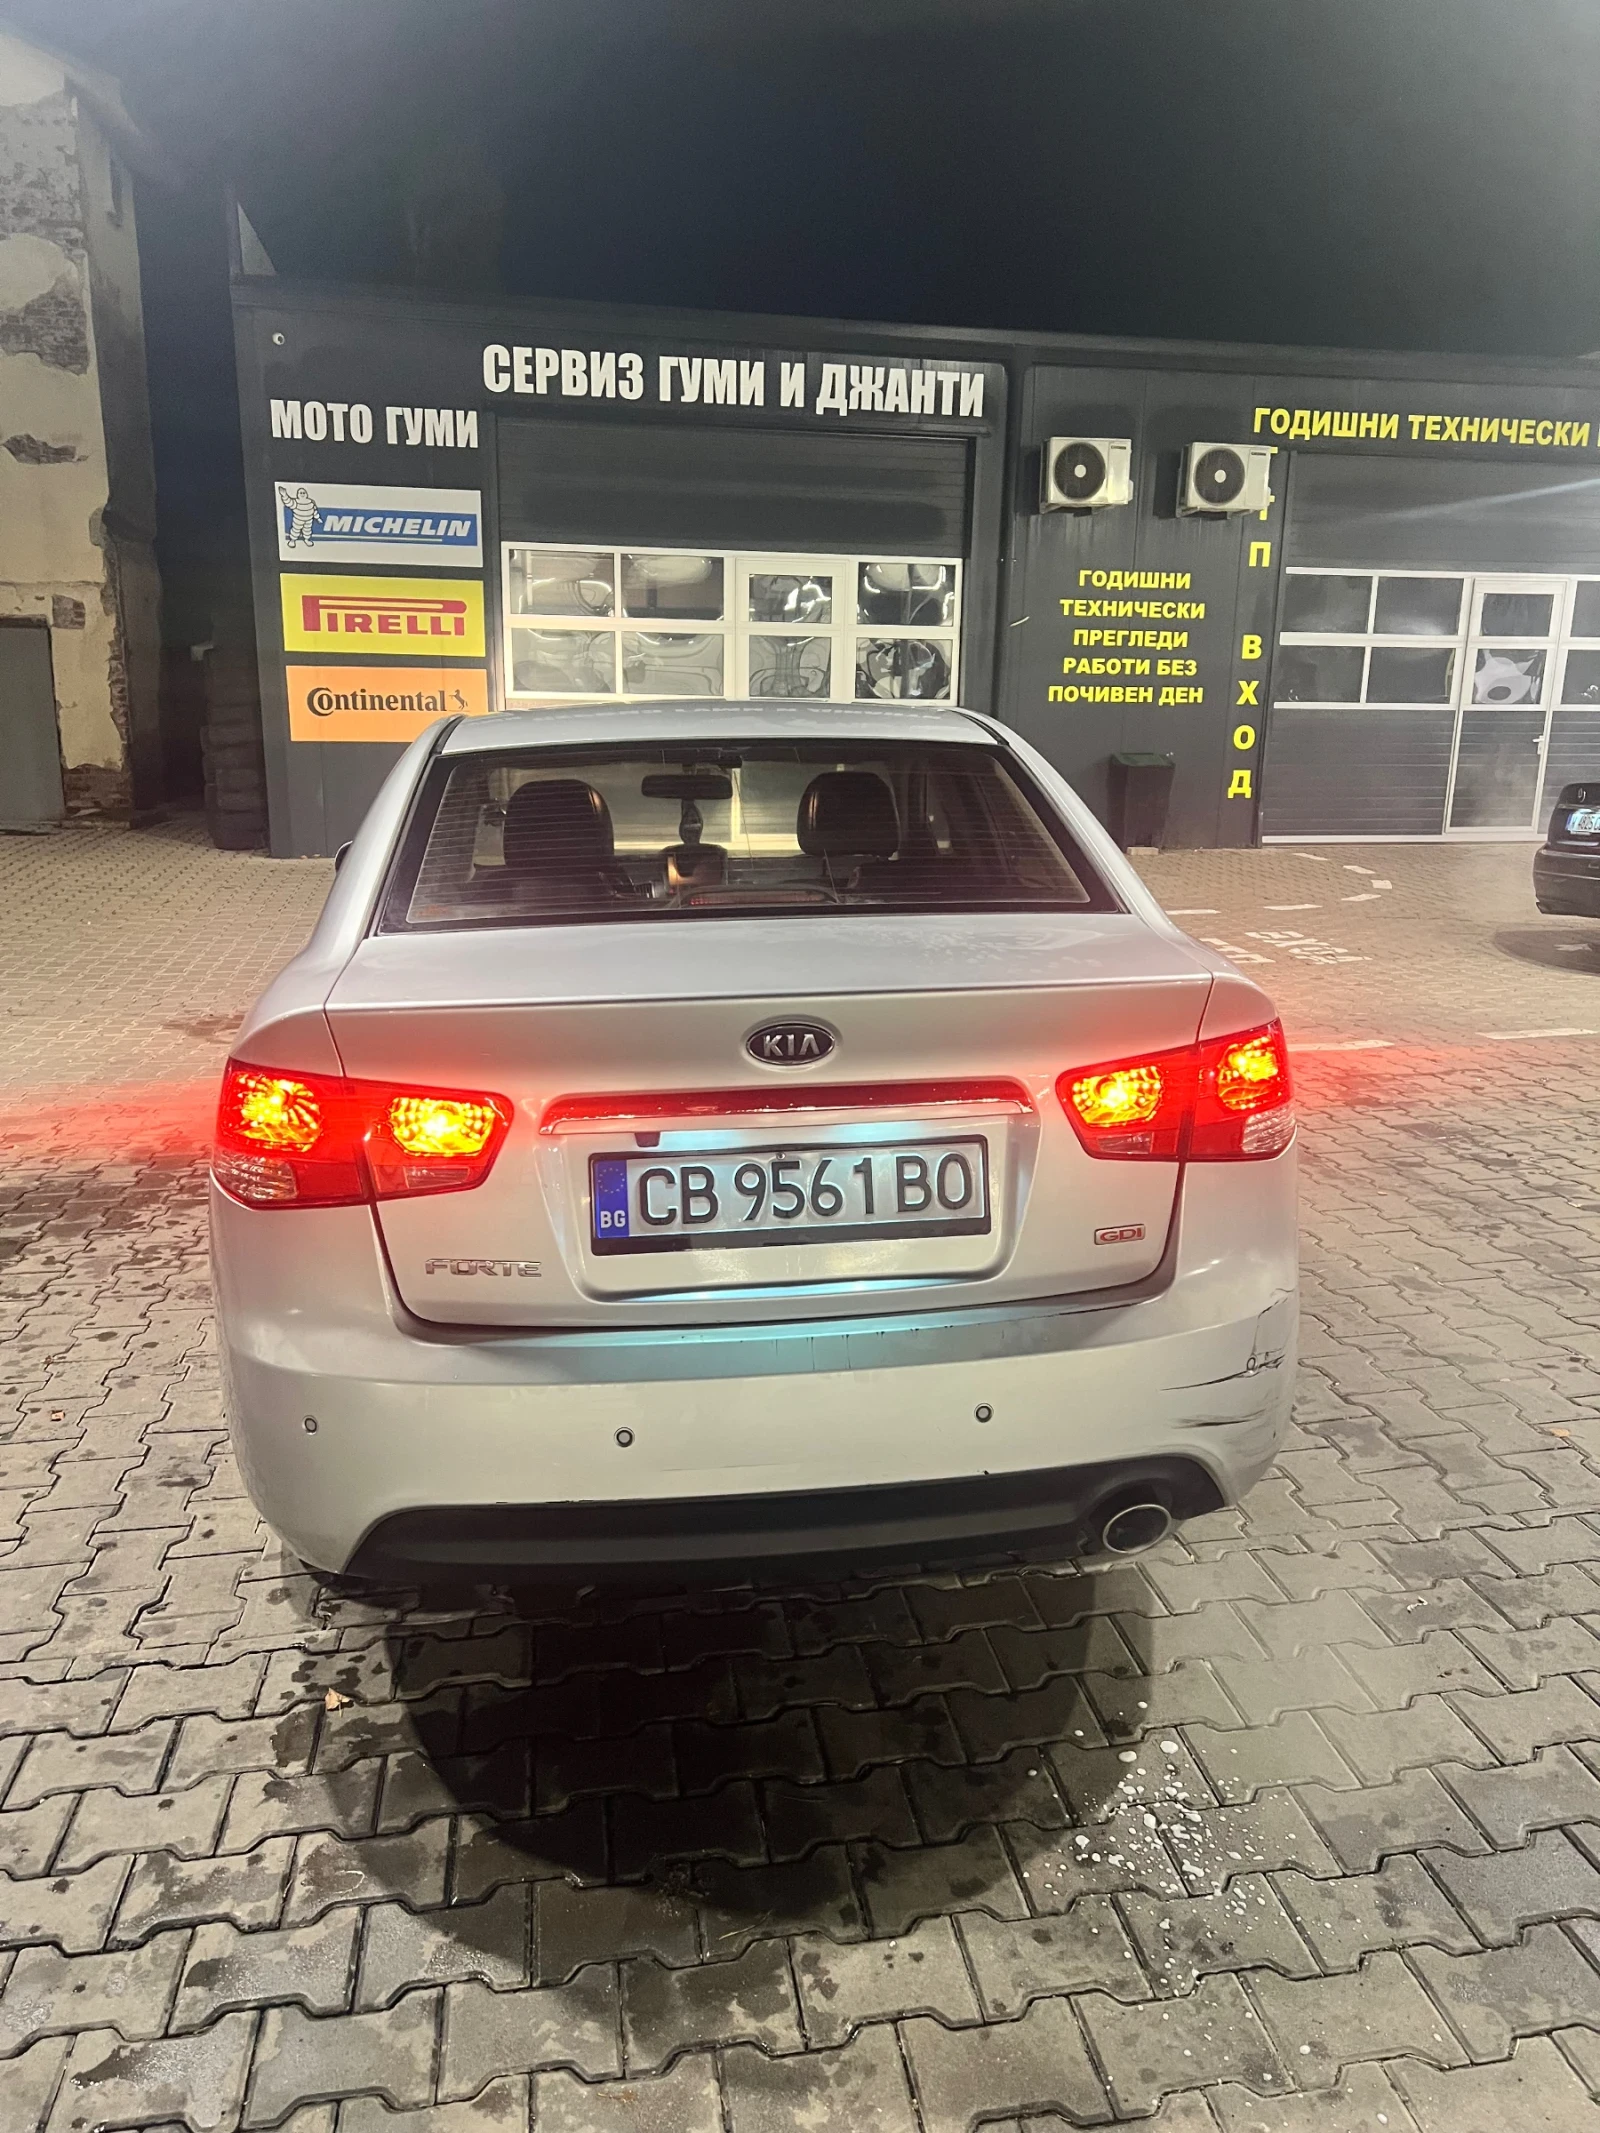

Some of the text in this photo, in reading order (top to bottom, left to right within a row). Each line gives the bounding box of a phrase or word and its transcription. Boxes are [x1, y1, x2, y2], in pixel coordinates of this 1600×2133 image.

[483, 344, 984, 417] СЕРВИЗ ГУМИ И ДЖАНТИ
[270, 399, 478, 448] МОТО ГУМИ
[1254, 408, 1399, 440] ГОДИШНИ
[1408, 414, 1590, 447] ТЕХНИЧЕСКИ
[323, 515, 471, 537] MICHELIN
[1079, 570, 1192, 590] ГОДИШНИ
[302, 595, 467, 636] PIRELLI
[1060, 599, 1205, 619] ТЕХНИЧЕСКИ
[1073, 629, 1188, 650] ПРЕГЛЕДИ
[1063, 658, 1198, 676] РАБОТИ БЕЗ
[307, 687, 447, 716] Continental
[1048, 686, 1204, 706] ПОЧИВЕН ДЕН
[1227, 634, 1263, 799] ВХОД
[763, 1033, 821, 1057] KIA
[734, 1157, 875, 1222] 9561
[600, 1210, 626, 1229] BG
[1100, 1228, 1142, 1241] GDI
[425, 1258, 542, 1277] FORTE
